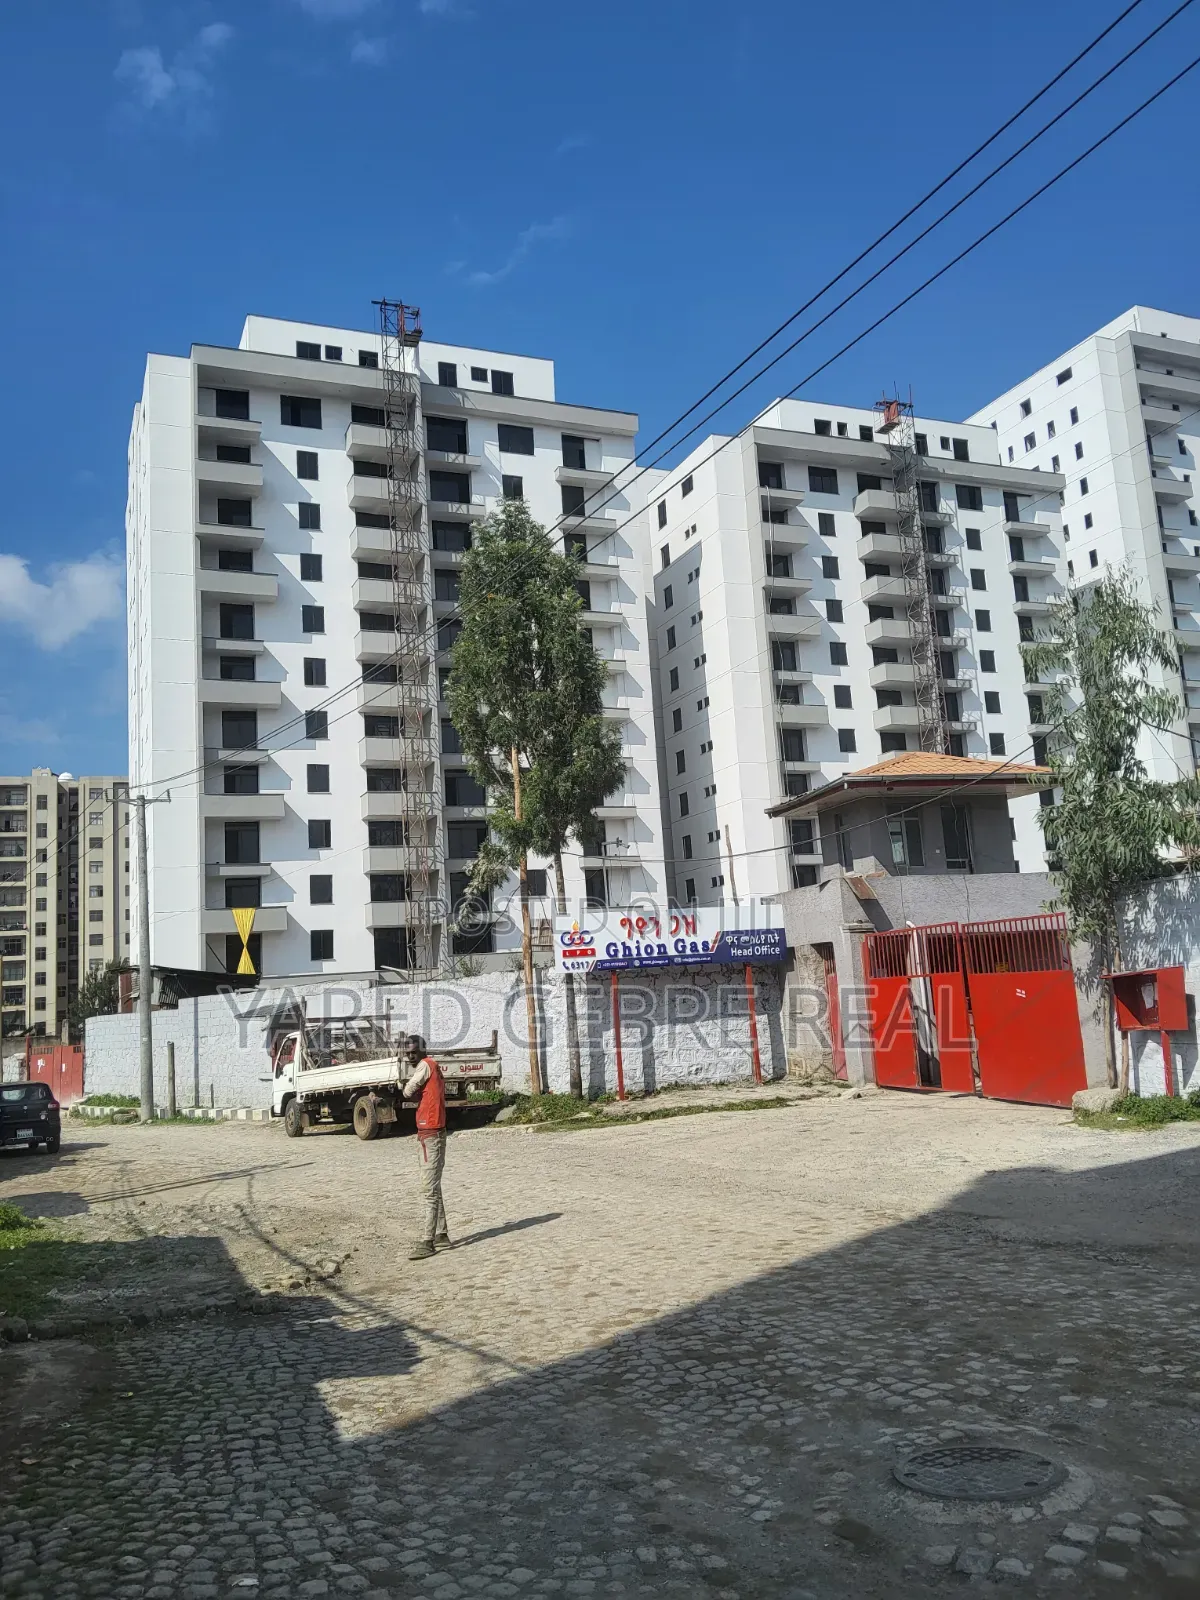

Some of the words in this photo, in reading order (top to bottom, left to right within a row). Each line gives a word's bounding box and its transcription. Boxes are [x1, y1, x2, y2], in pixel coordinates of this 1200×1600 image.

[605, 938, 667, 959] Ghion
[674, 937, 710, 956] Gas
[731, 946, 753, 957] Head
[754, 945, 780, 956] Office
[570, 960, 590, 970] 6317
